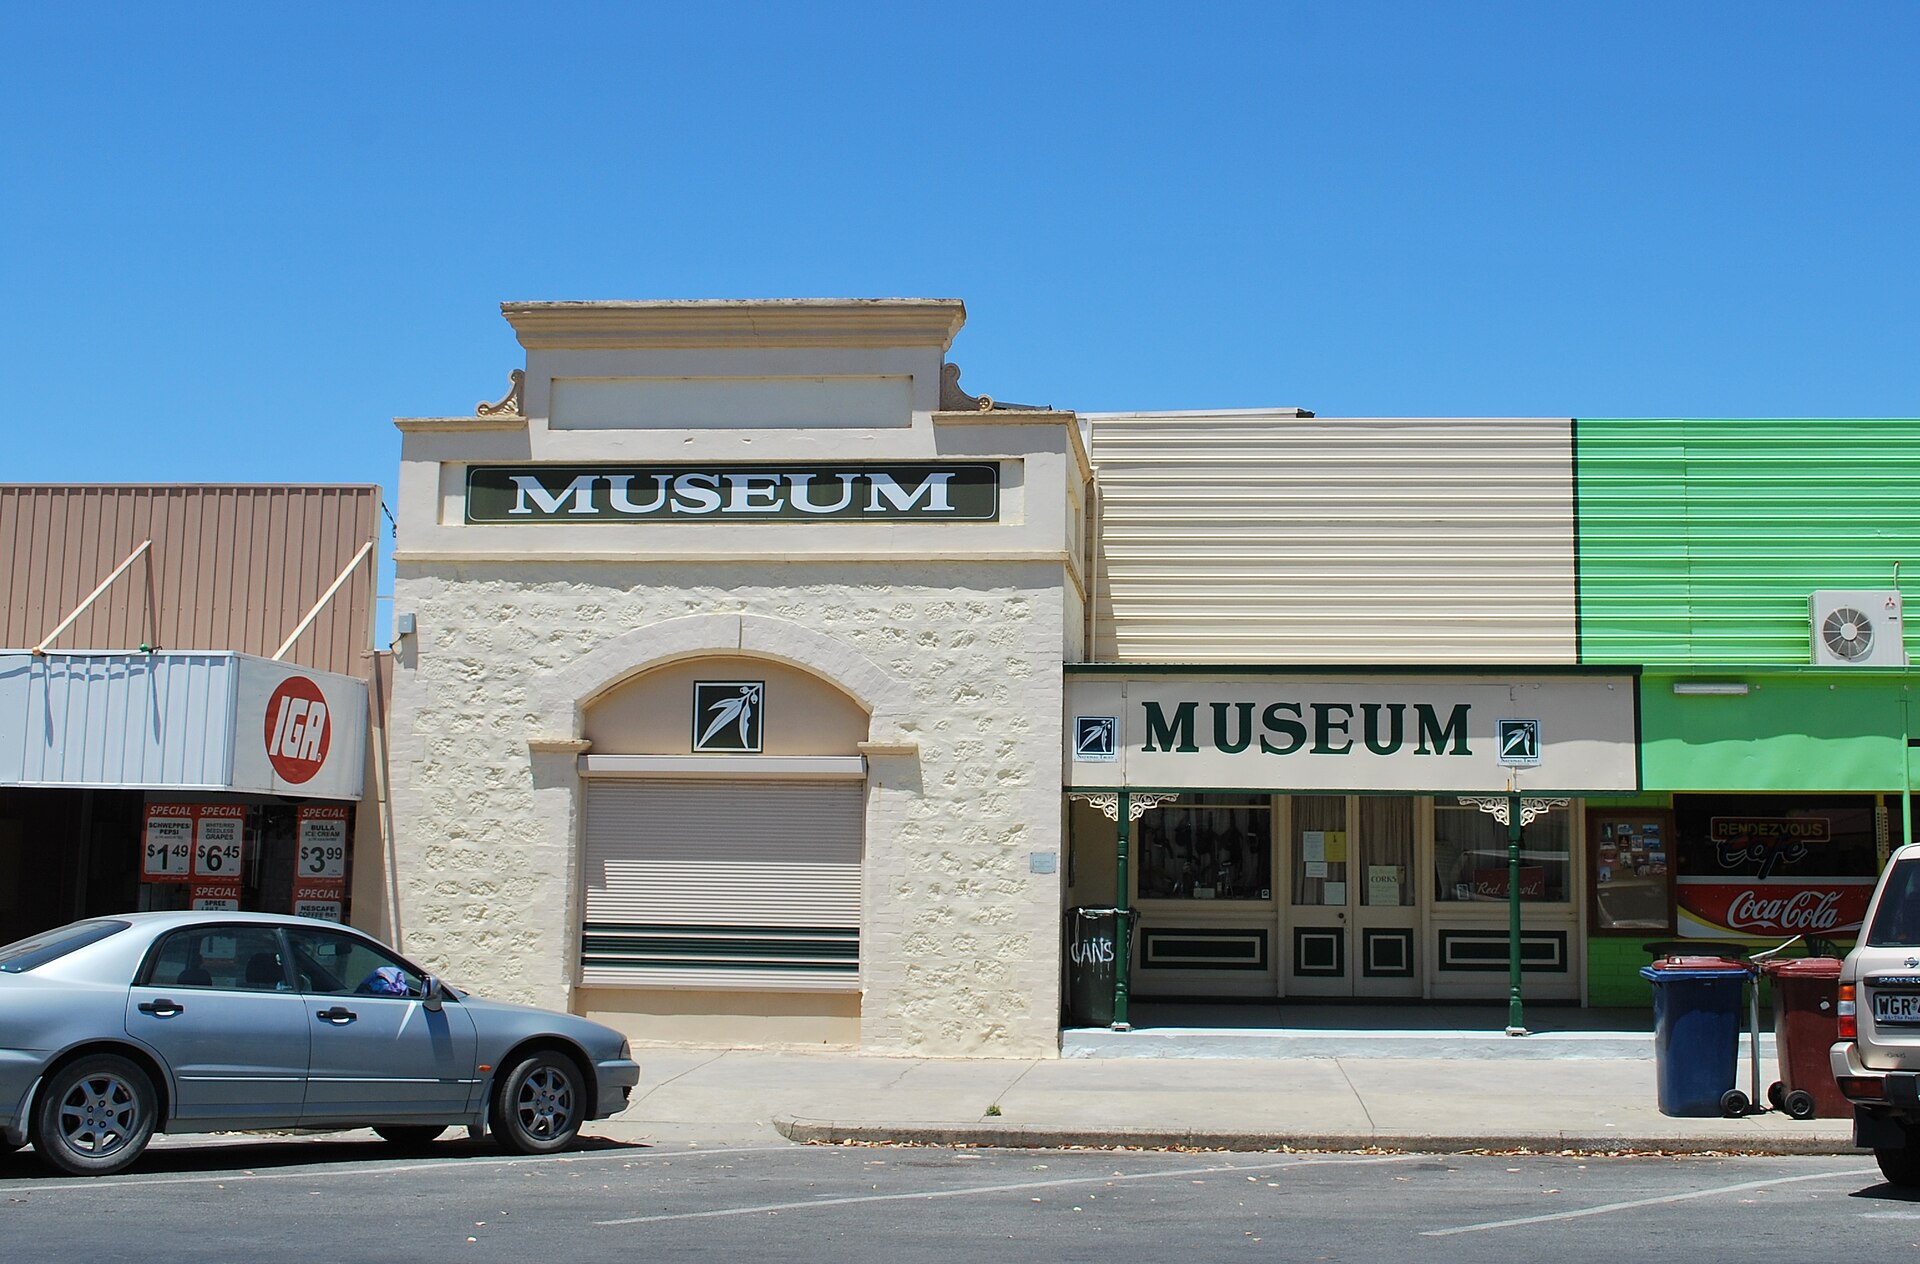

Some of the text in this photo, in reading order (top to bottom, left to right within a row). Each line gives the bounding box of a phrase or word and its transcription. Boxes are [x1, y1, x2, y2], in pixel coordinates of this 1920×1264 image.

[508, 472, 956, 514] MUSEUM
[269, 695, 326, 762] IGA
[1141, 701, 1473, 756] MUSEUM
[150, 805, 192, 815] SPECIAL
[200, 806, 242, 816] SPECIAL
[302, 808, 344, 818] SPECIAL
[1719, 822, 1823, 837] RENDEZVOUS
[195, 887, 237, 897] SPECIAL
[297, 888, 340, 899] SPECIAL
[1727, 890, 1843, 929] Coca-Cola
[1071, 938, 1115, 964] CANS
